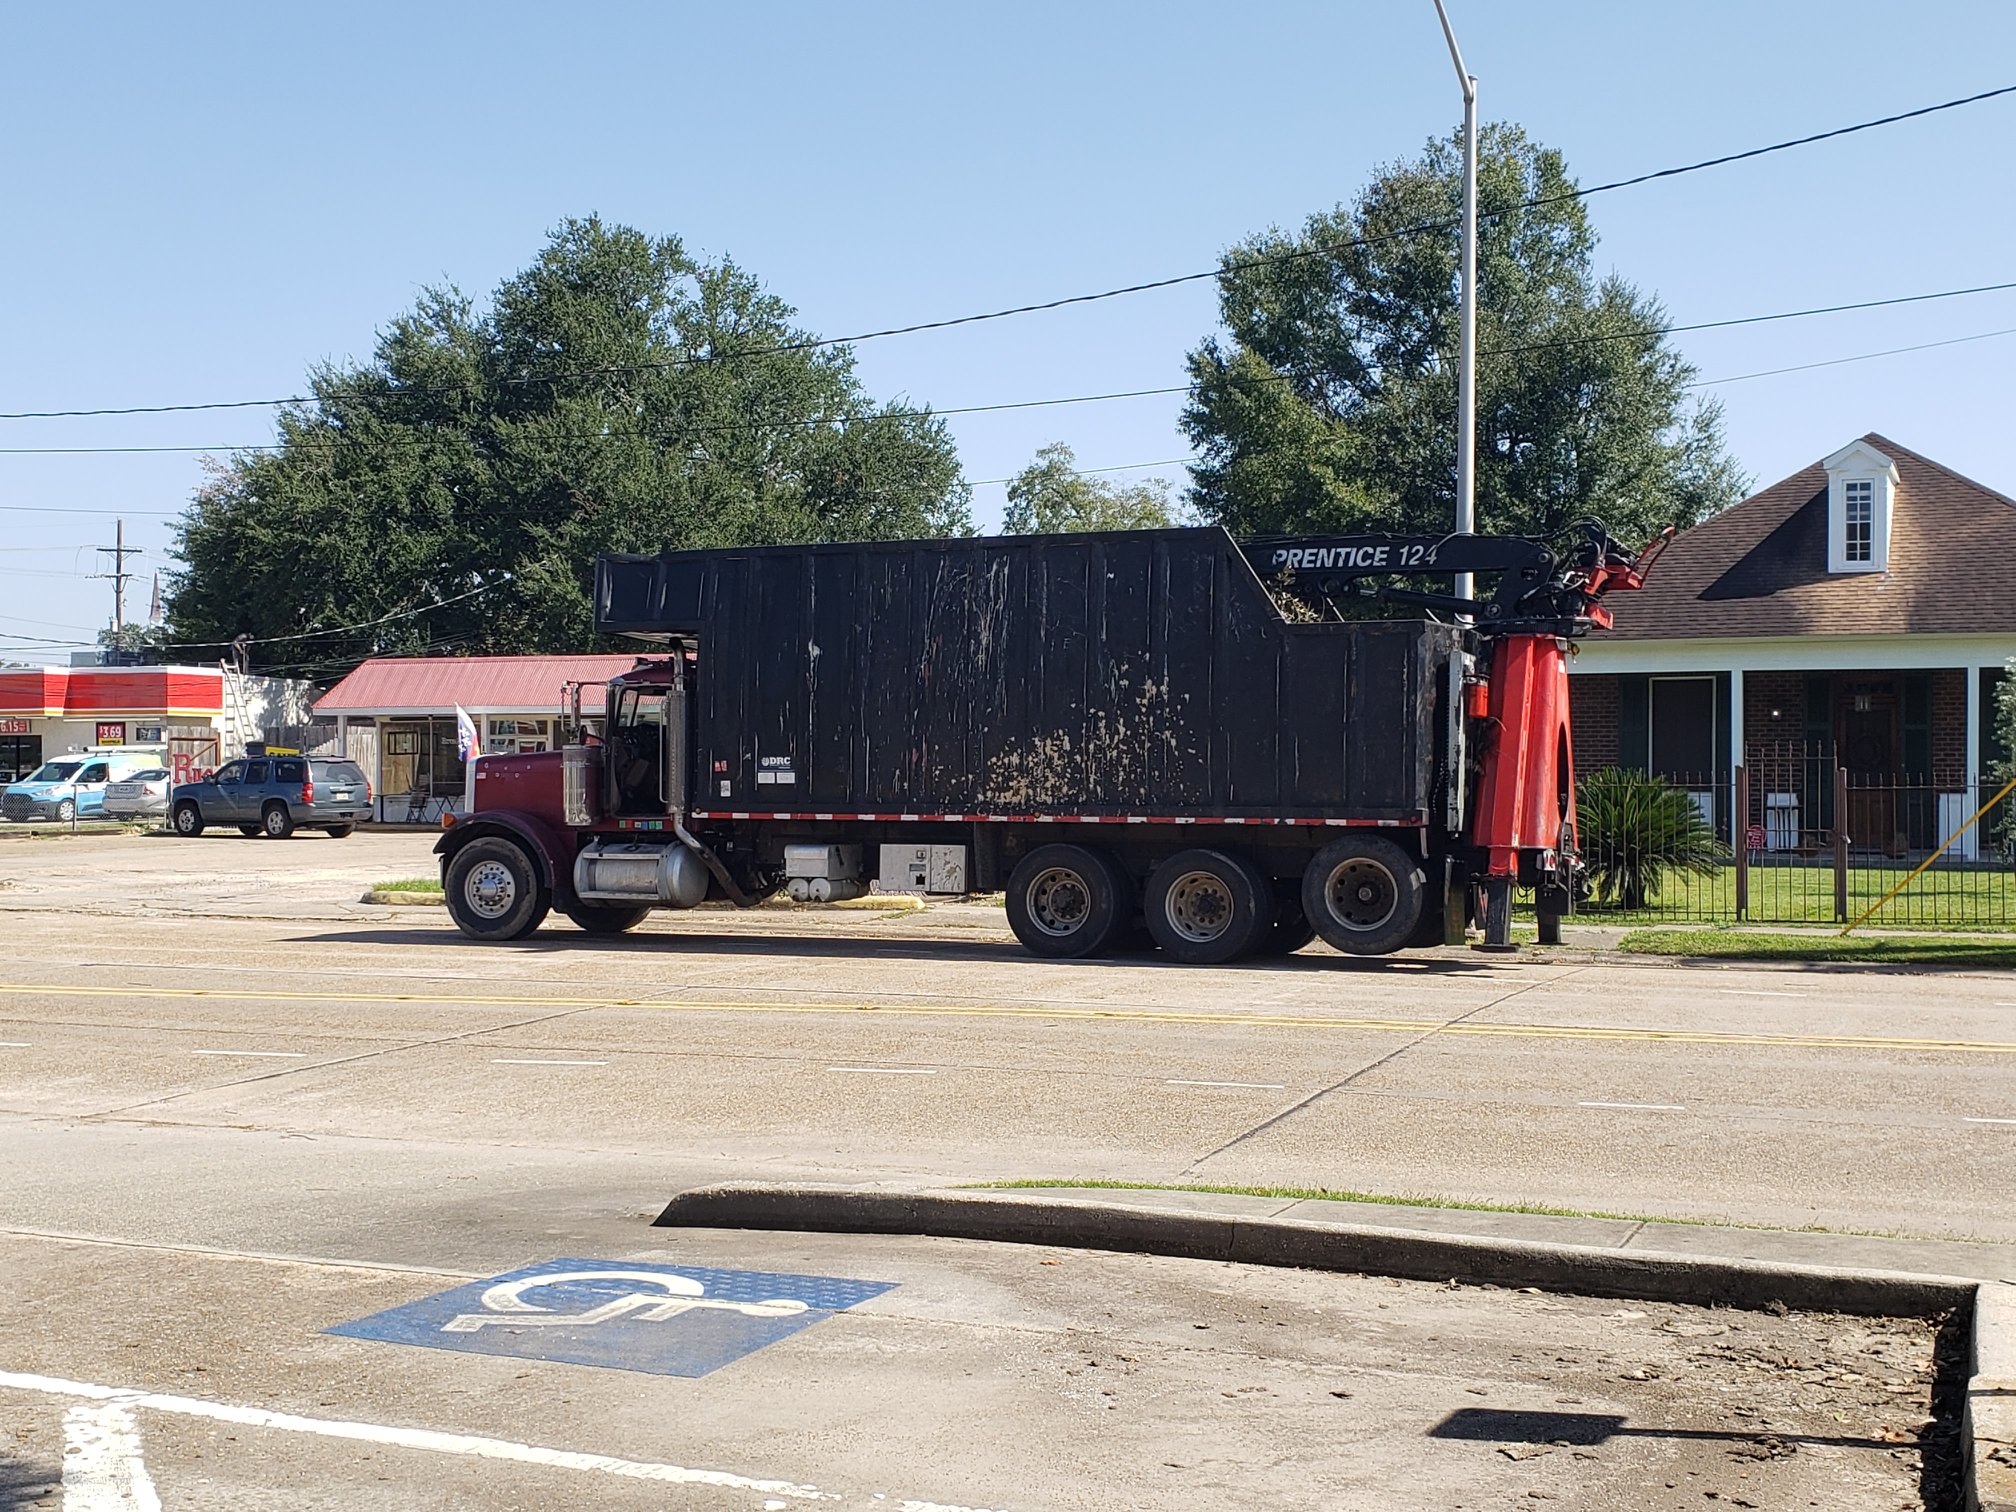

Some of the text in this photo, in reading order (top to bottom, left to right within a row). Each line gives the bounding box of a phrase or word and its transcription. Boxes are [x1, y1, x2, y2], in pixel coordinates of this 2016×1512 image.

[1272, 545, 1437, 568] PRENTICE 124
[769, 757, 791, 765] DRC
